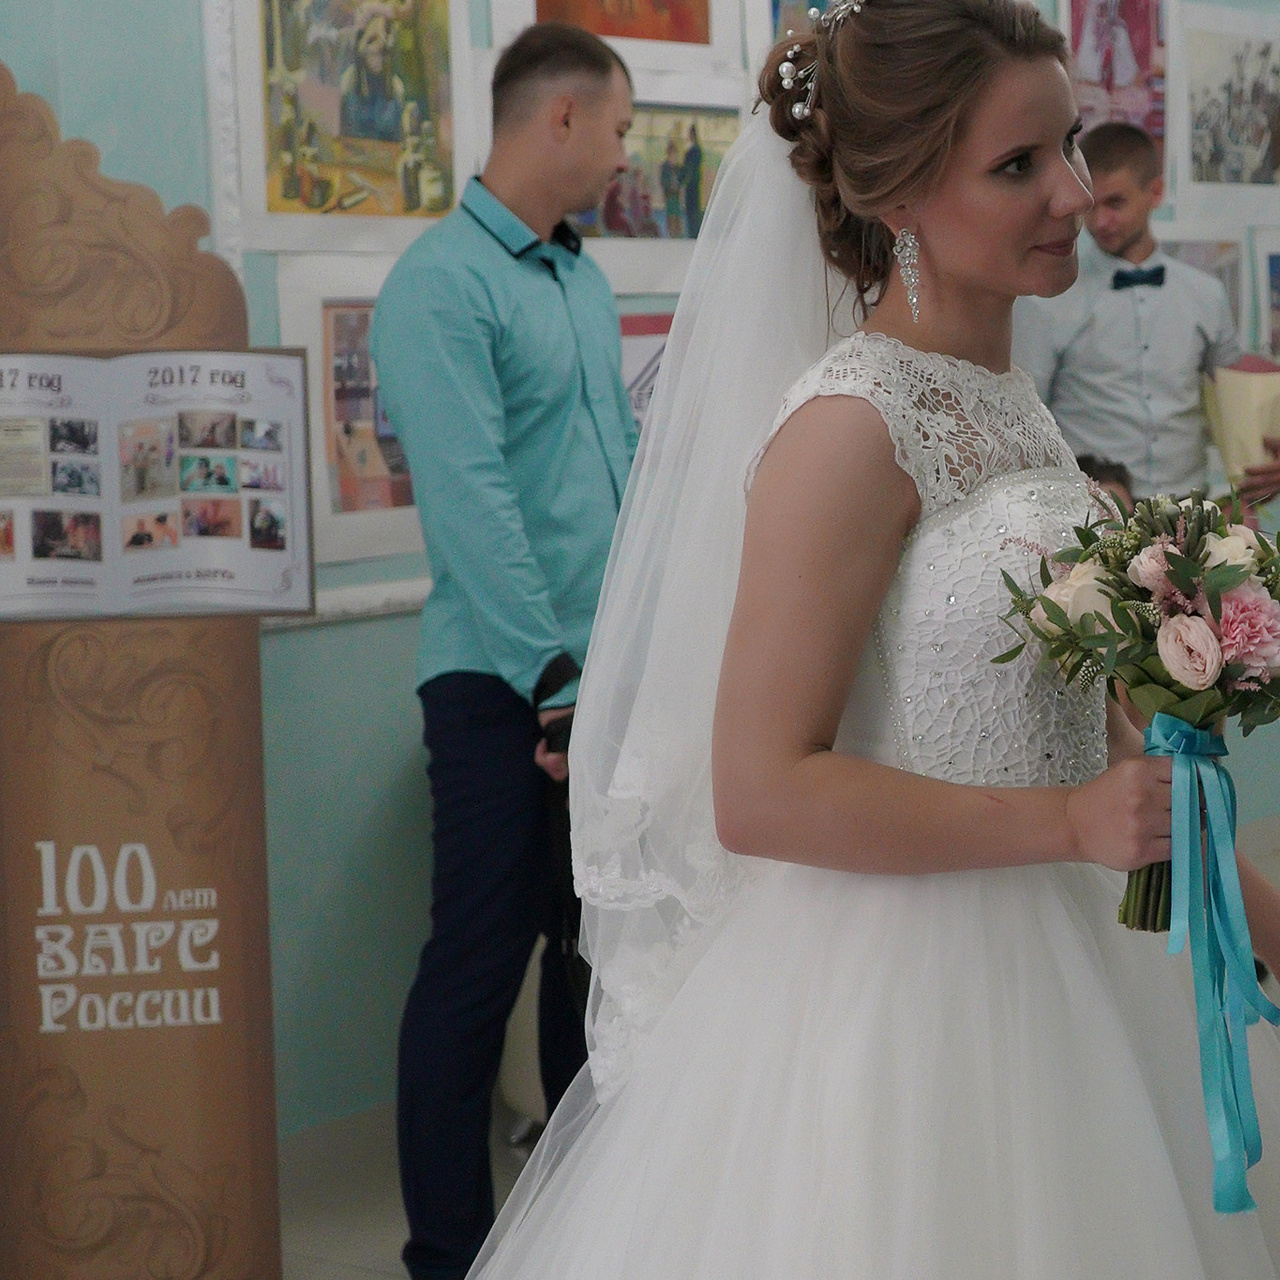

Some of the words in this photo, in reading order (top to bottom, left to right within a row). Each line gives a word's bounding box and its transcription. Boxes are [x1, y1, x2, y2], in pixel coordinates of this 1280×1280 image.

[148, 365, 200, 388] 2017
[34, 840, 157, 917] 100
[163, 887, 217, 912] лет
[38, 983, 222, 1034] России
